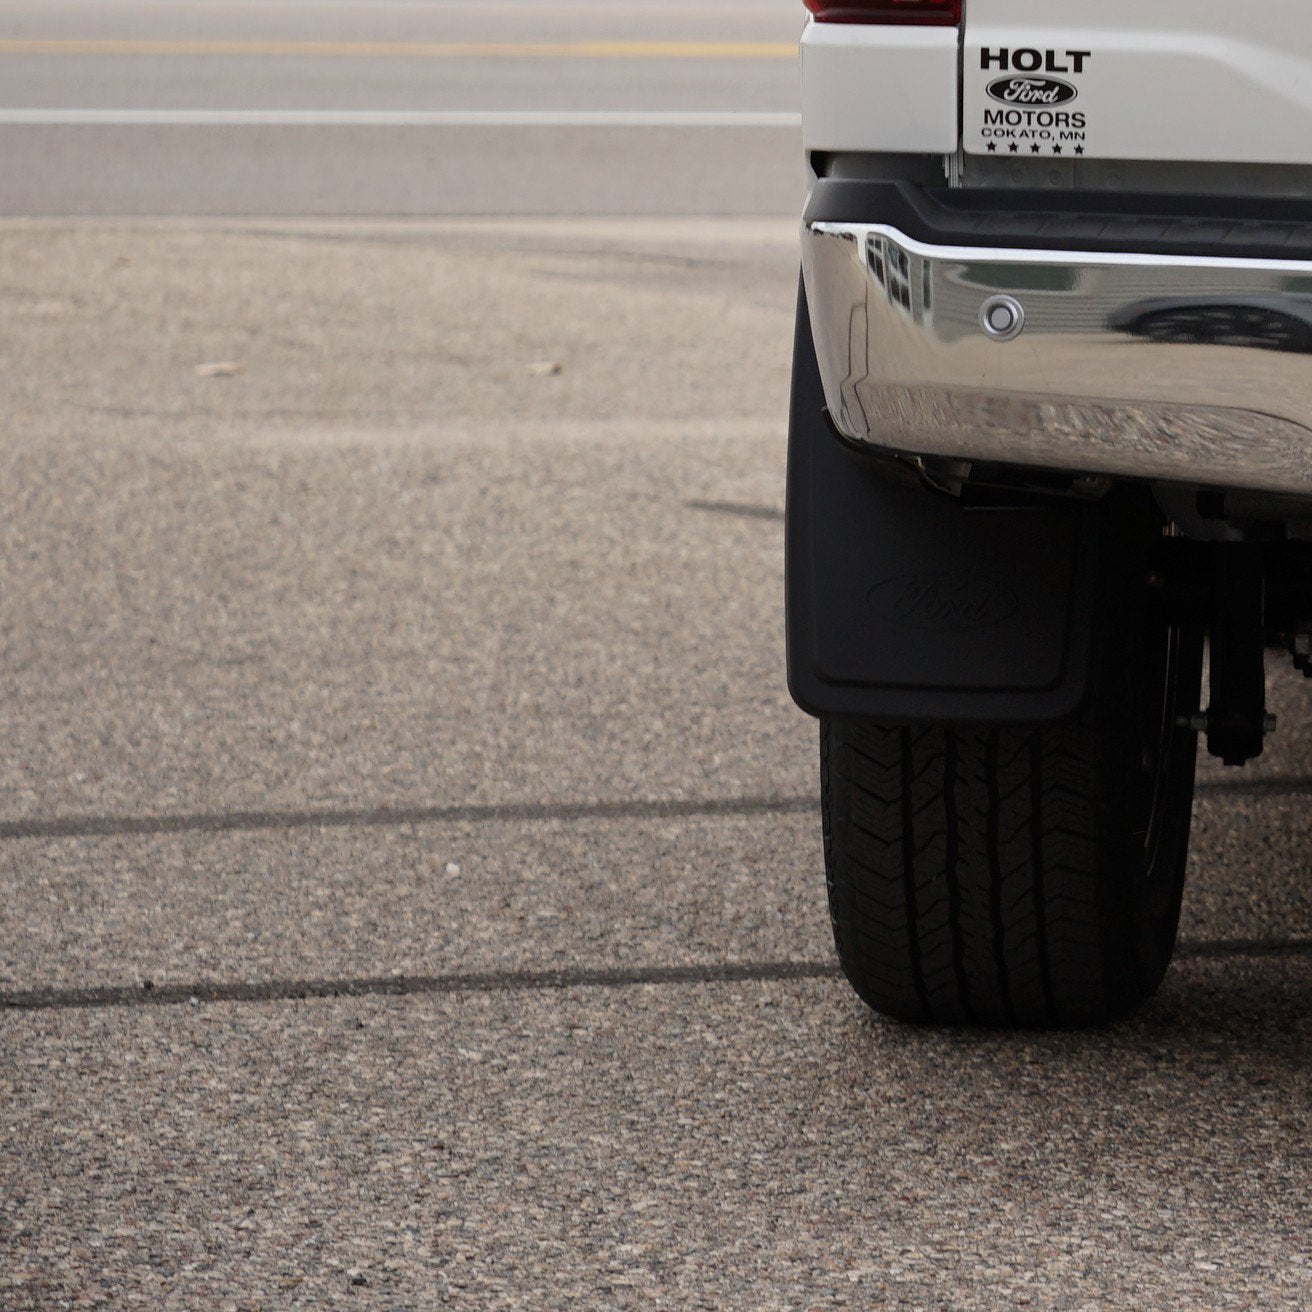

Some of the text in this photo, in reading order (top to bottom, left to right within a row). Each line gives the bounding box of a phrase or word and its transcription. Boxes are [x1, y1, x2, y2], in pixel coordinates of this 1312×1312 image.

[980, 46, 1092, 73] HOLT
[1003, 78, 1060, 104] Ford
[983, 109, 1087, 129] MOTORS
[980, 128, 1086, 141] COKATO, MN
